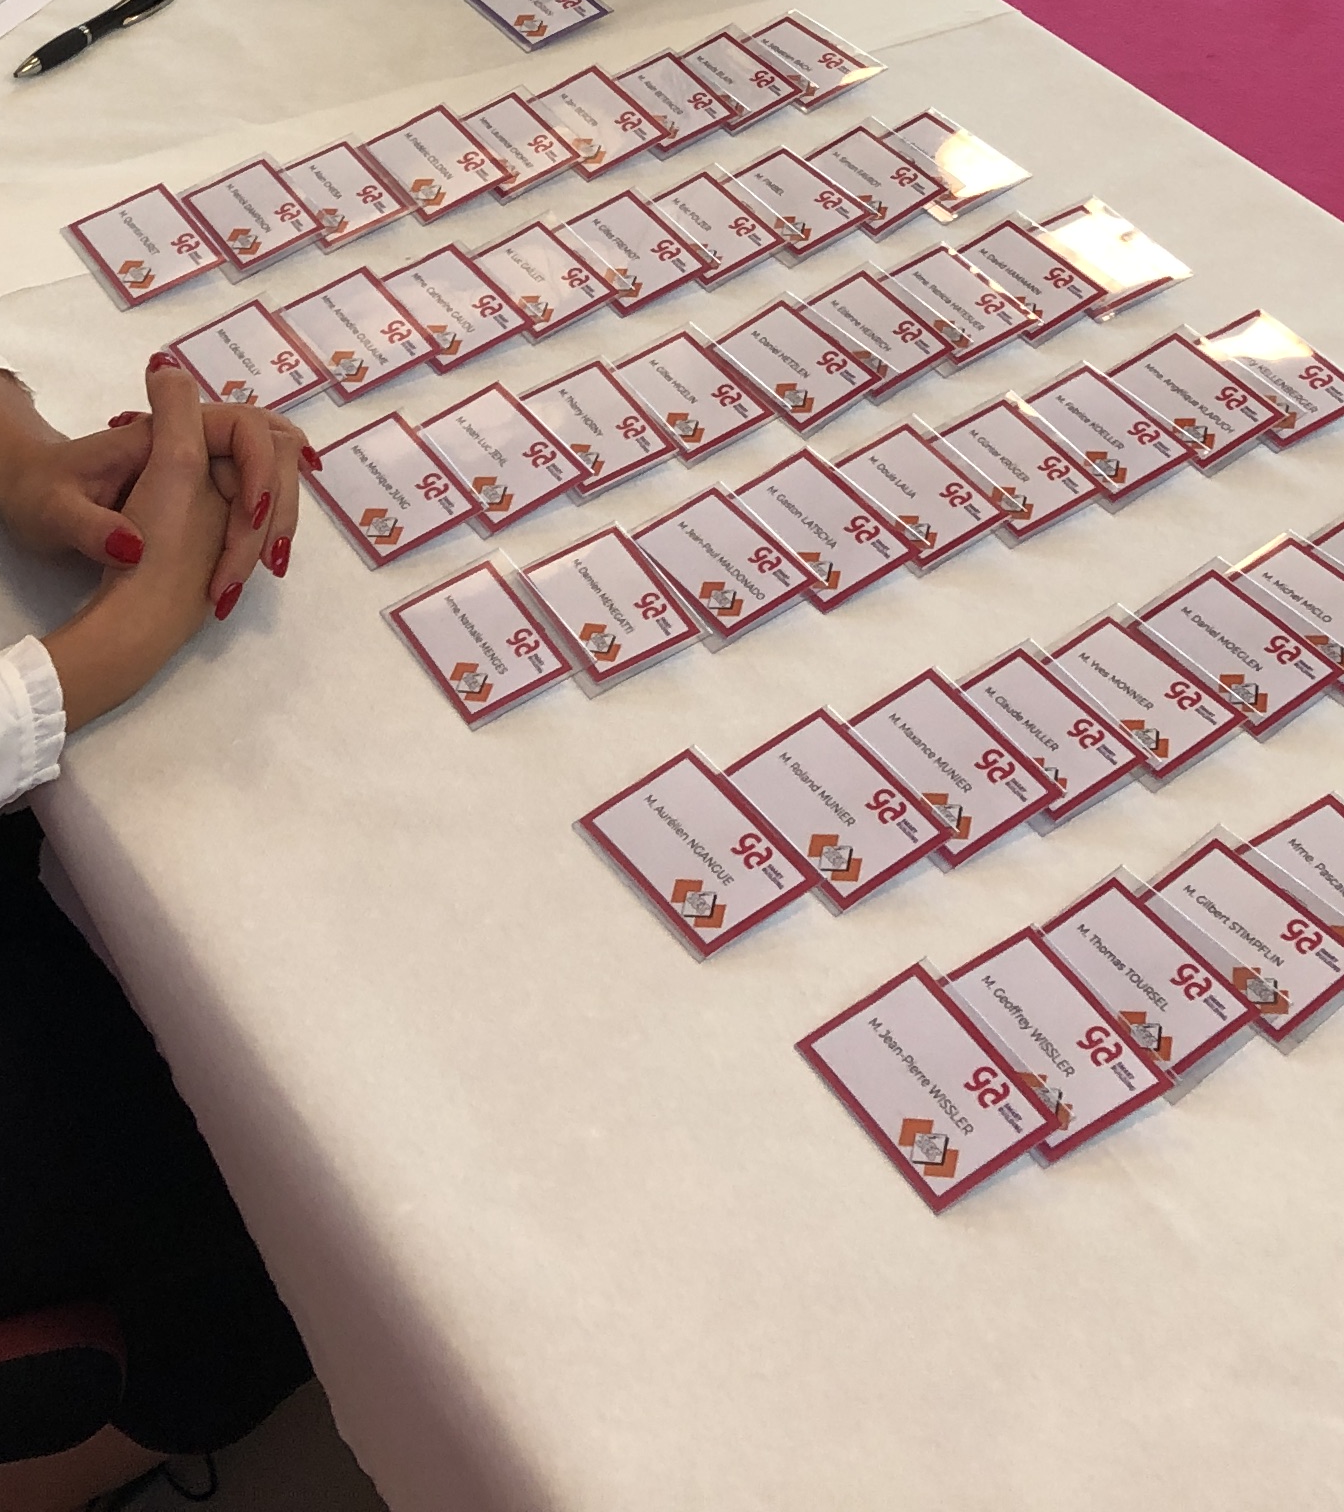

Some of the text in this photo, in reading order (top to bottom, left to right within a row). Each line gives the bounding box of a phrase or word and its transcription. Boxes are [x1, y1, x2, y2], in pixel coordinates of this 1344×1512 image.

[1250, 364, 1318, 413] KELLENBERGER
[775, 493, 803, 518] Gaston
[800, 515, 837, 549] LATSCHA
[577, 565, 602, 594] Damien
[684, 527, 721, 559] Jean-Paul
[717, 555, 766, 600] MALDONADO
[1272, 579, 1304, 602] Michel
[1299, 599, 1332, 623] MICLO
[478, 640, 508, 675] MENGES
[1190, 613, 1221, 638] Daniel
[1217, 635, 1263, 672] MOEGLEN
[1090, 659, 1110, 678] Yves
[1108, 674, 1154, 710] MONNIER
[994, 695, 1024, 721] Claude
[1021, 718, 1059, 752] MULLER
[897, 722, 936, 759] Maxance
[932, 756, 972, 793] MUNIER
[789, 761, 822, 792] Roland
[817, 789, 856, 827] MUNIER
[686, 837, 735, 886] NGANGUE
[1287, 837, 1314, 865] Mme.
[1195, 894, 1230, 924] Gilbert
[1227, 920, 1285, 967] STIMPFLIN
[1088, 933, 1126, 971] Thomas
[1124, 967, 1168, 1012] TOURSEL
[992, 987, 1033, 1030] Geoffrey
[1029, 1027, 1075, 1078] WISSLER
[877, 1028, 931, 1087] Jean-Pierre
[928, 1083, 974, 1136] WISSLER
